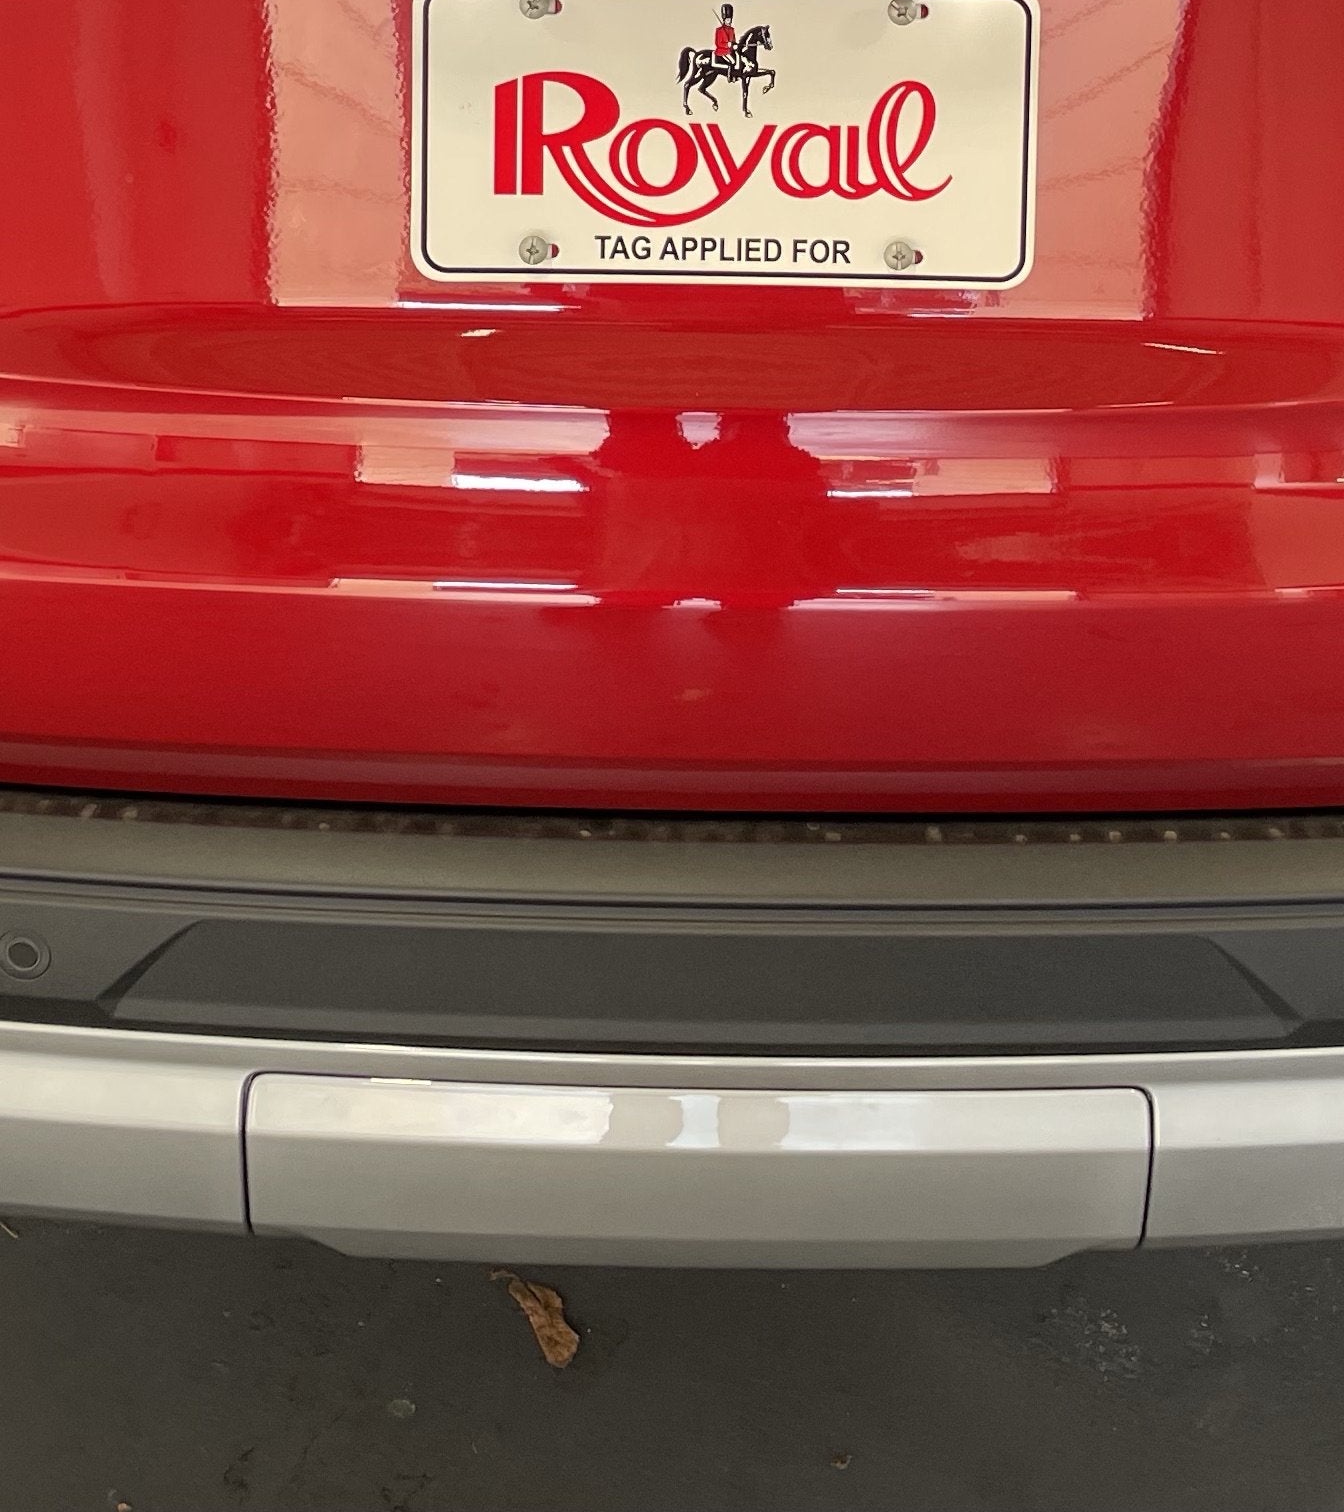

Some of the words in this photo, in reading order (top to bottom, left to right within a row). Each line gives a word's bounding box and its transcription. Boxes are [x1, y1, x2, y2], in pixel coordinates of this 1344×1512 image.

[493, 71, 953, 228] Royal
[594, 235, 652, 260] TAG
[659, 236, 782, 262] APPLIED
[792, 239, 851, 264] FOR
